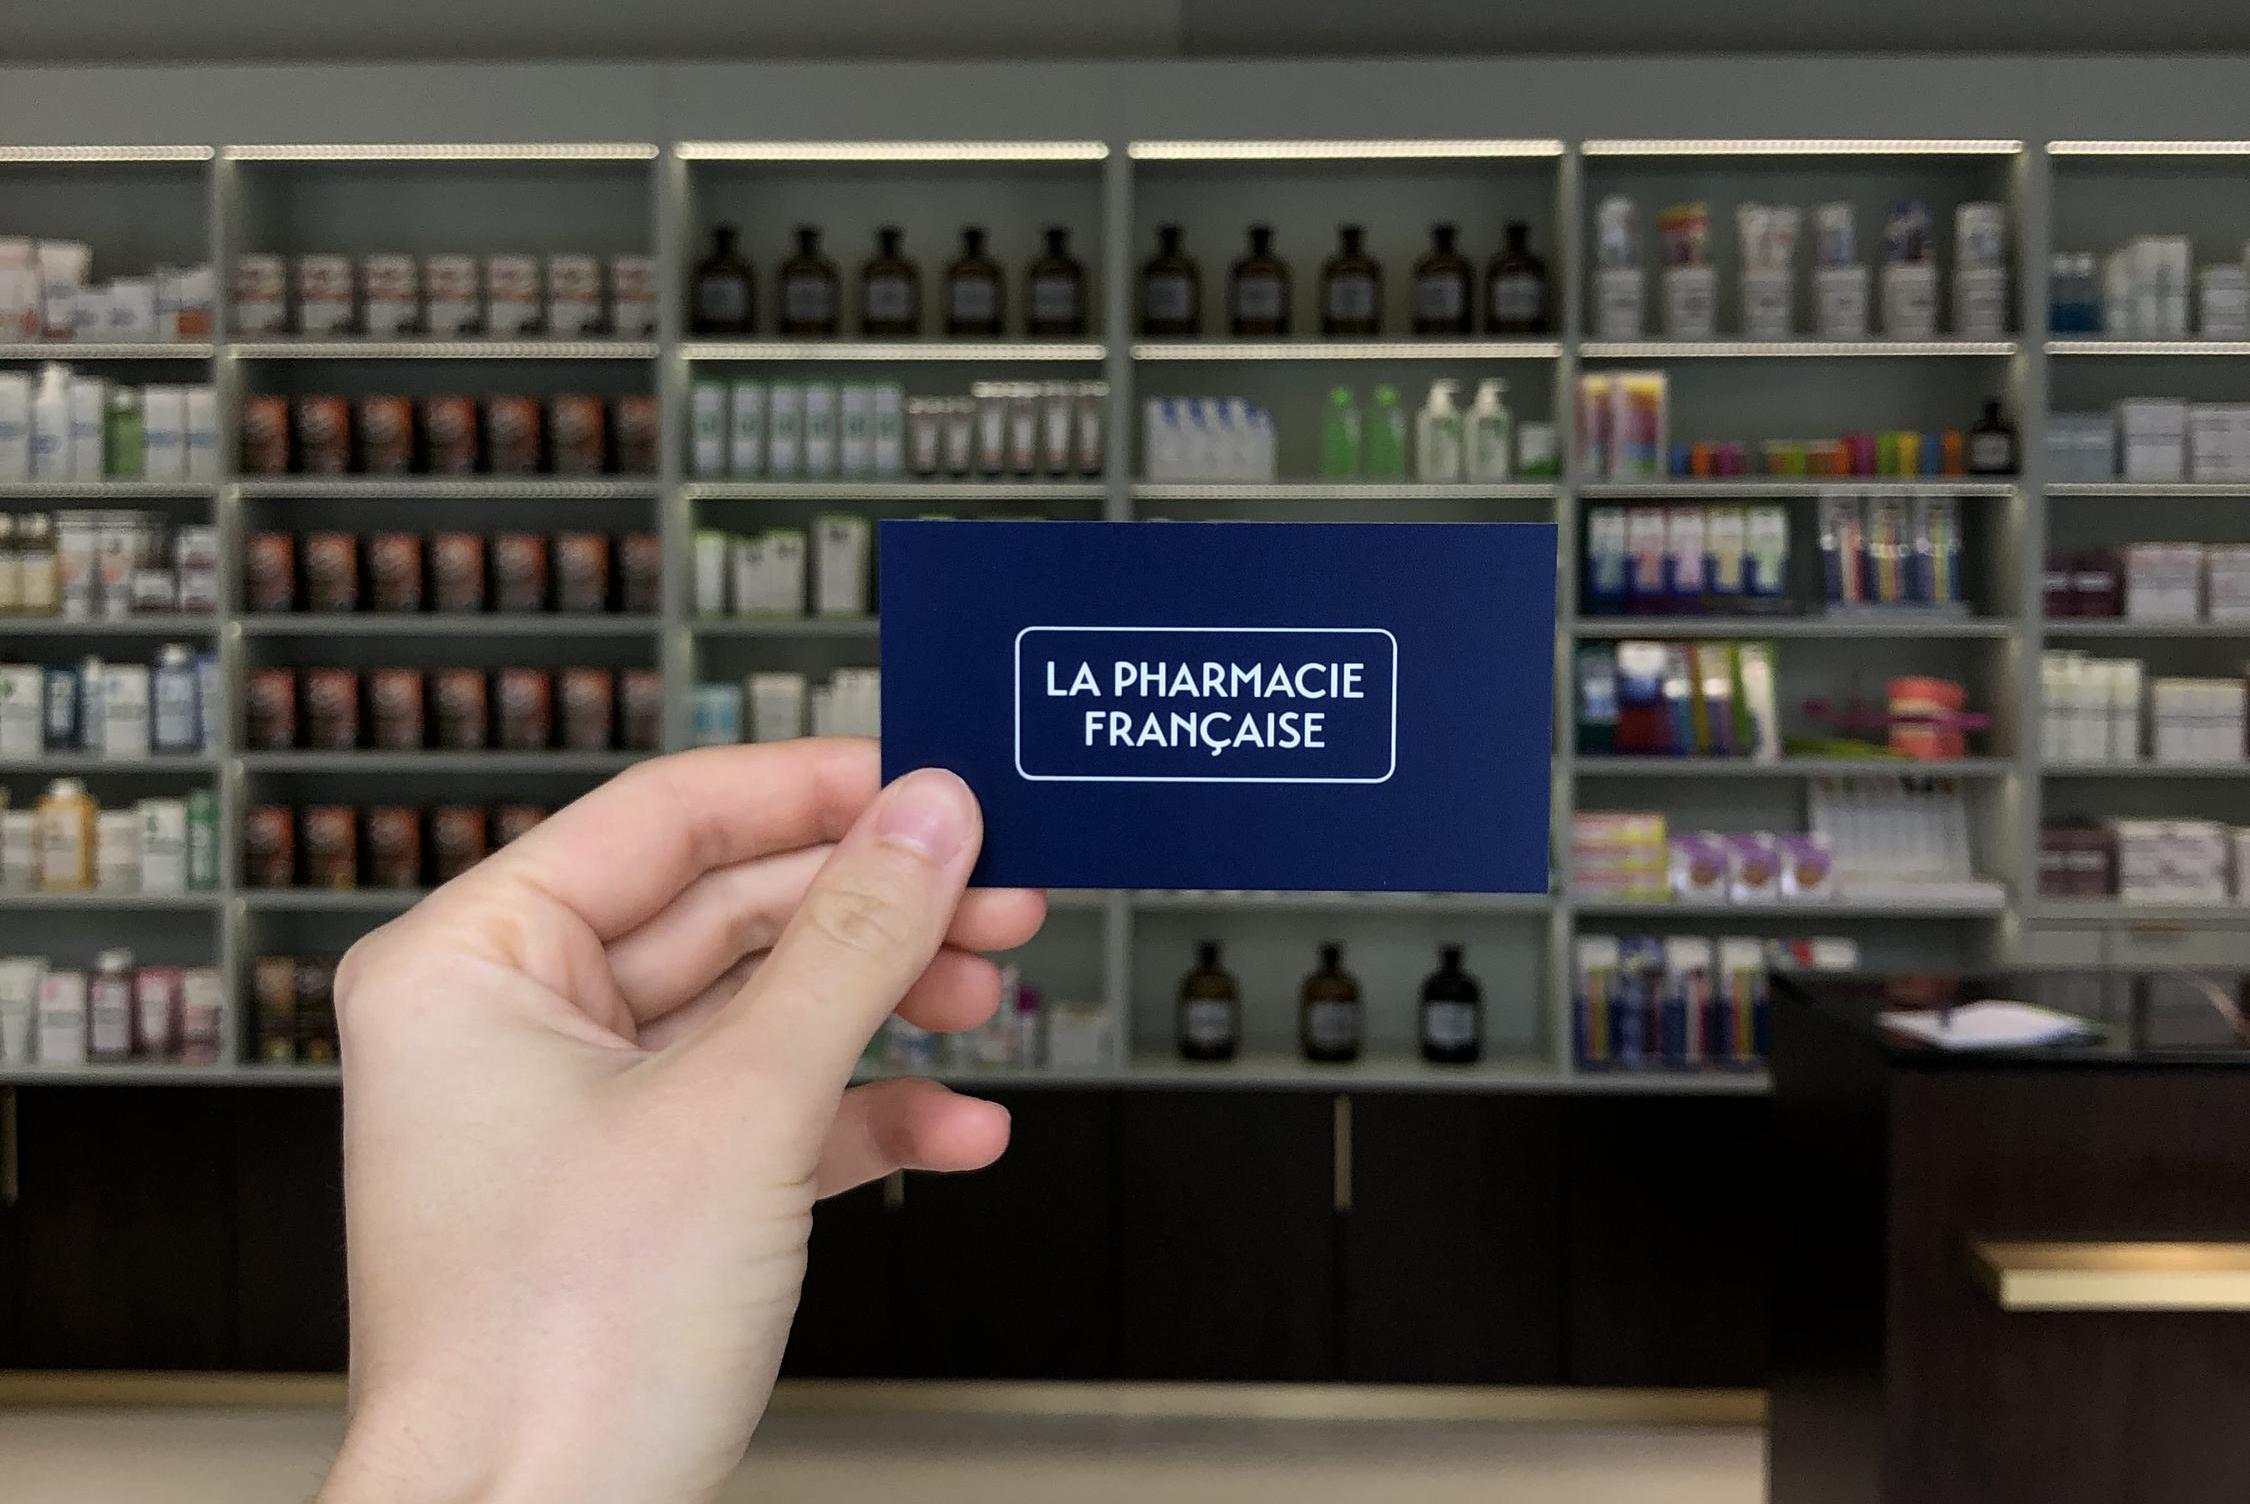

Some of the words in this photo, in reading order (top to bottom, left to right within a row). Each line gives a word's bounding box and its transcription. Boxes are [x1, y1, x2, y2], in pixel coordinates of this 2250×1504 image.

[1046, 660, 1102, 697] LA
[1114, 661, 1365, 699] PHARMACIE
[1085, 710, 1326, 757] FRANÇAISE
